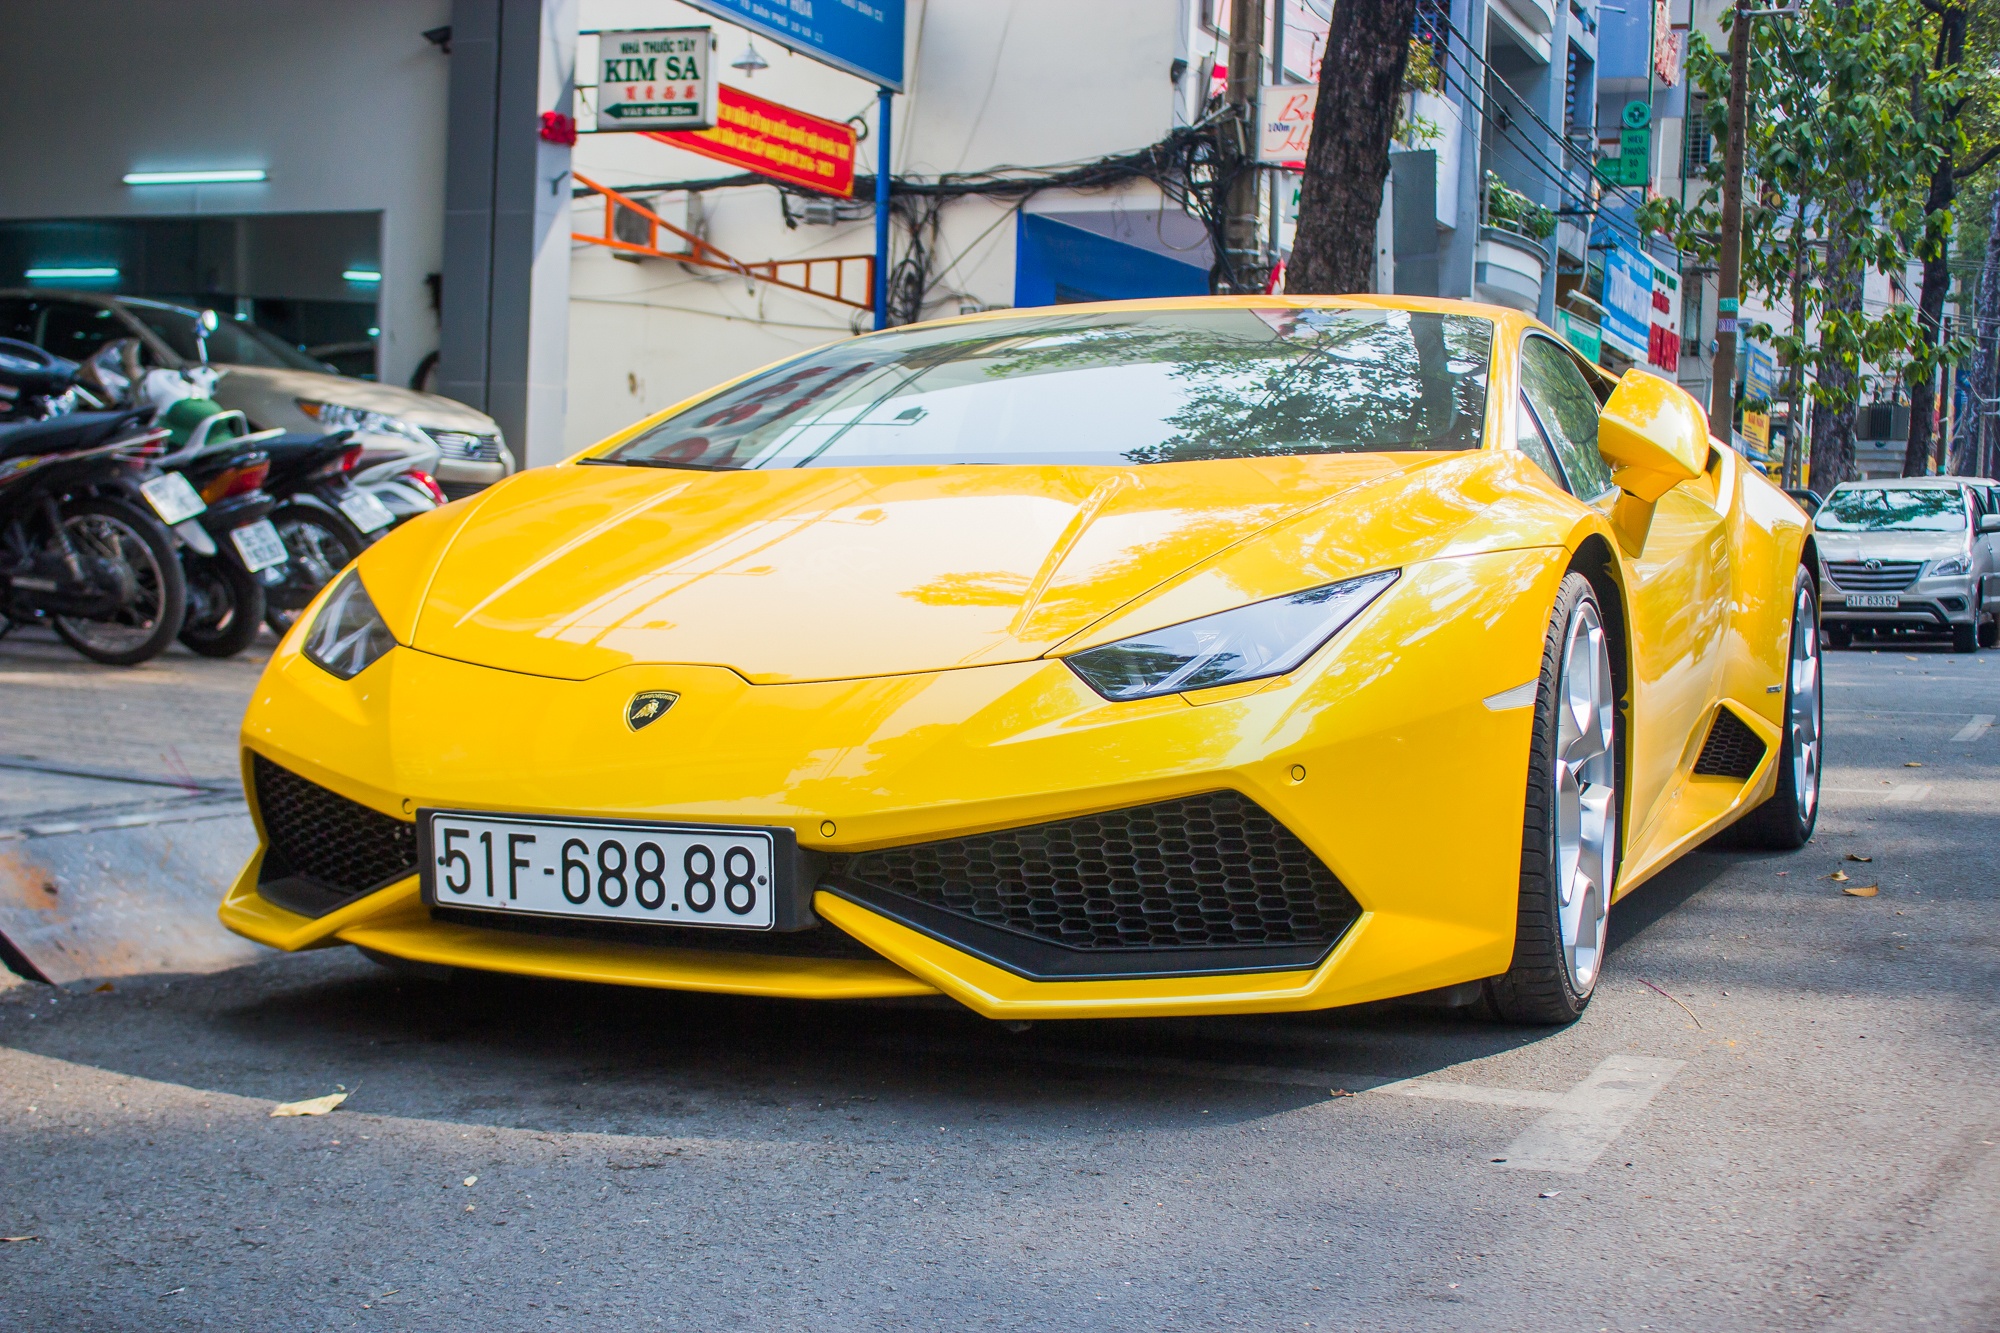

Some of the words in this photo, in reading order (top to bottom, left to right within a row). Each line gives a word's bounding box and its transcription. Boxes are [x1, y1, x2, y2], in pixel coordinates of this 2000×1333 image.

[604, 57, 657, 83] KIM
[665, 55, 701, 81] SA
[443, 827, 757, 916] 51F-688.88
